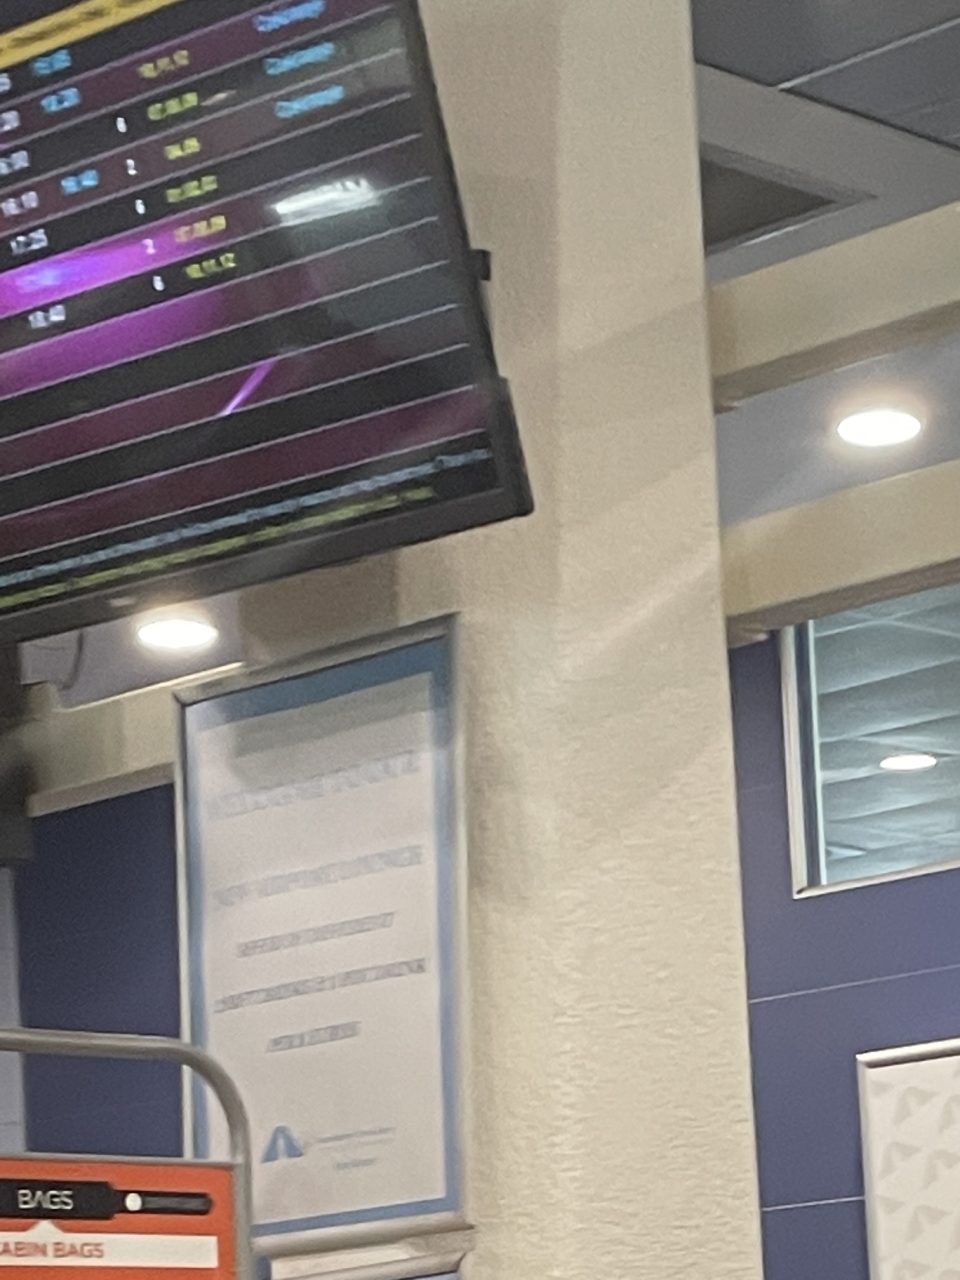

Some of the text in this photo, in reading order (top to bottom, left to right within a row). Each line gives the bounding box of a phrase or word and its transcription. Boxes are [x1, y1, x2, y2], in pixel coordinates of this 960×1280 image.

[18, 1189, 74, 1210] BAGS
[0, 1241, 104, 1259] ABIN BAGS
